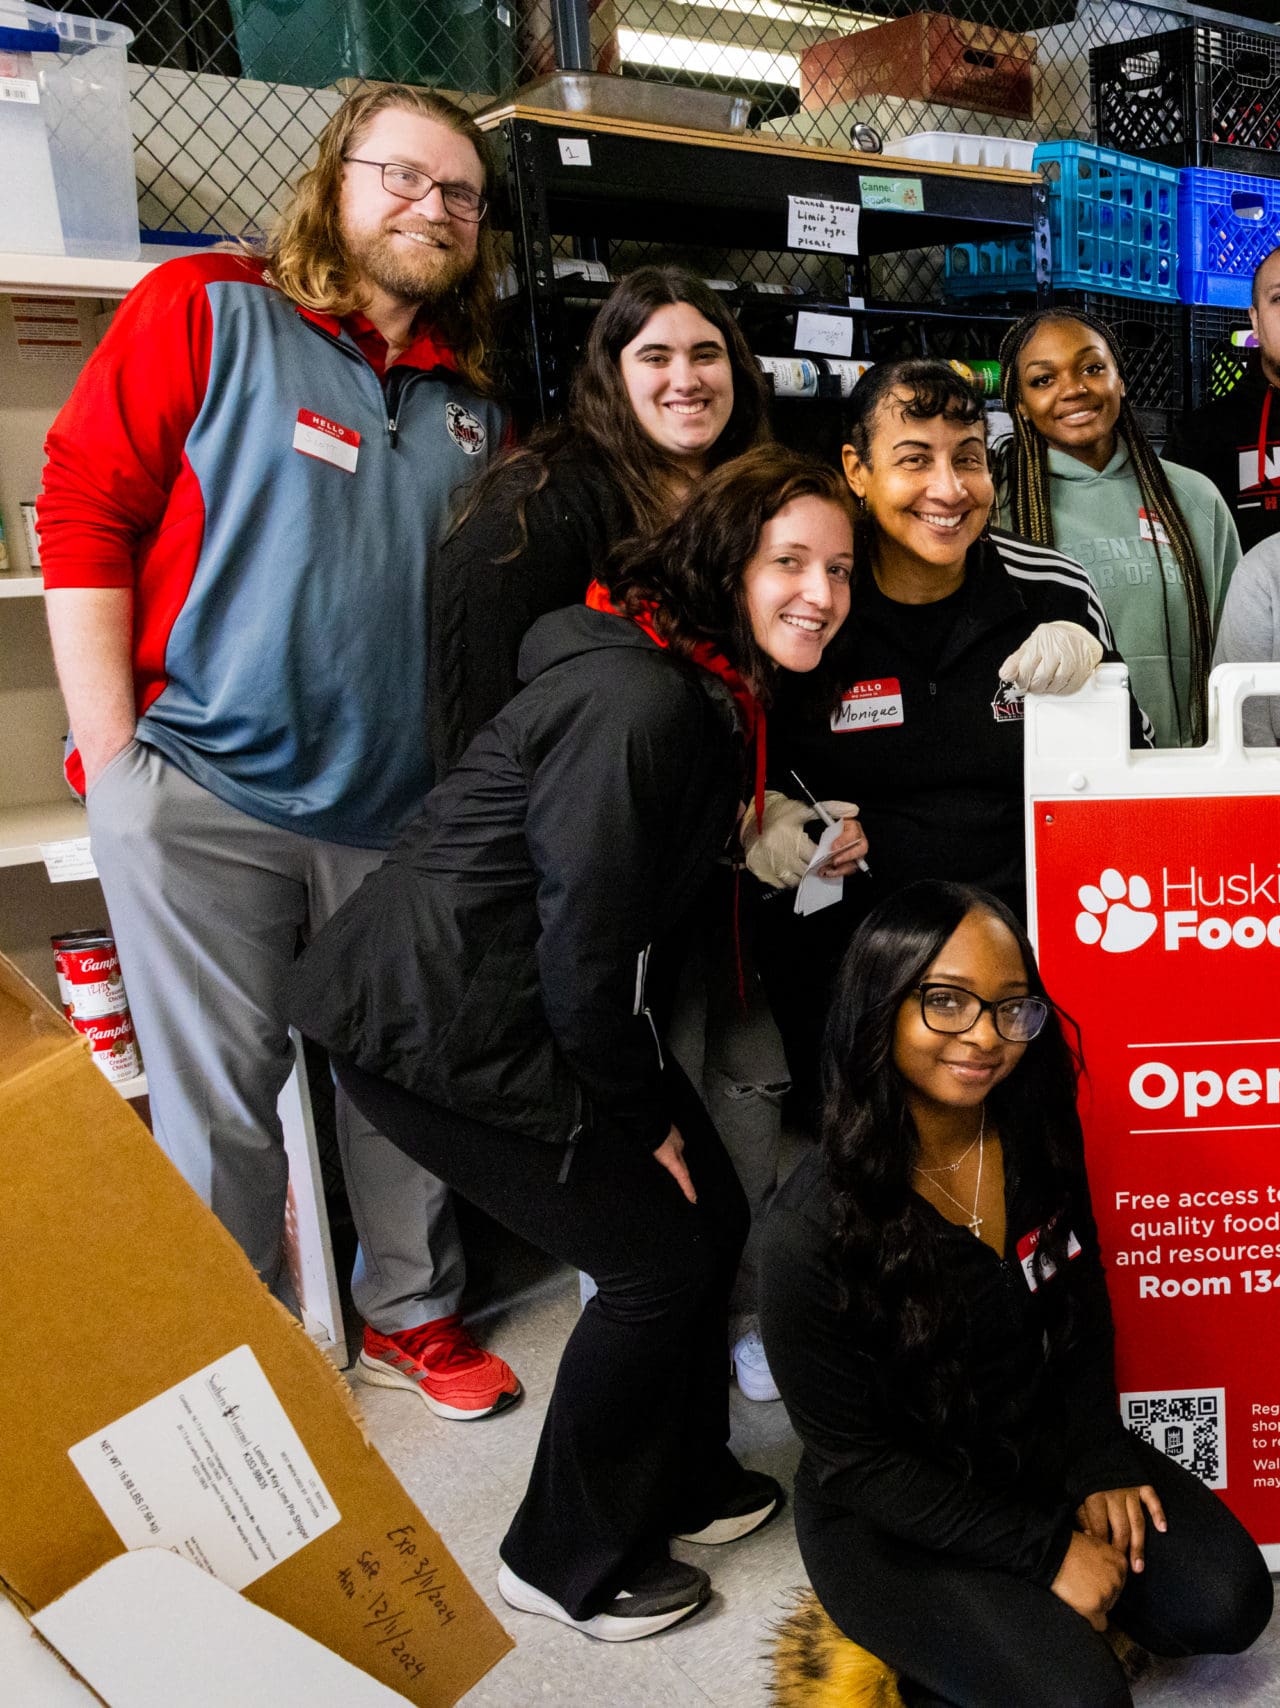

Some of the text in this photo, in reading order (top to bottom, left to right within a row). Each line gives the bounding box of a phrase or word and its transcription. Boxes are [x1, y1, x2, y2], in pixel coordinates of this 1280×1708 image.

[565, 146, 579, 159] 1
[861, 182, 895, 192] Canned
[798, 210, 837, 224] Limit 2
[830, 204, 855, 214] goods
[803, 224, 846, 238] per type
[798, 238, 831, 249] please
[312, 416, 345, 436] HELLO
[834, 704, 898, 726] Monique
[1116, 1192, 1169, 1209] Free
[1179, 1190, 1258, 1207] access
[1131, 1217, 1214, 1240] quality
[1117, 1246, 1160, 1265] and
[1140, 1276, 1230, 1298] Room
[1252, 1437, 1267, 1448] to
[101, 1440, 114, 1455] NET
[130, 1489, 144, 1505] LBS
[243, 1452, 268, 1489] K353-98635
[253, 1445, 269, 1469] Lemon
[270, 1474, 280, 1488] Key
[277, 1487, 289, 1504] Lime
[287, 1504, 295, 1515] Pie
[293, 1515, 309, 1539] Shipper
[357, 1551, 380, 1580] Safe
[400, 1558, 456, 1626] 3/11/2024
[363, 1595, 426, 1679] 12/11/2024
